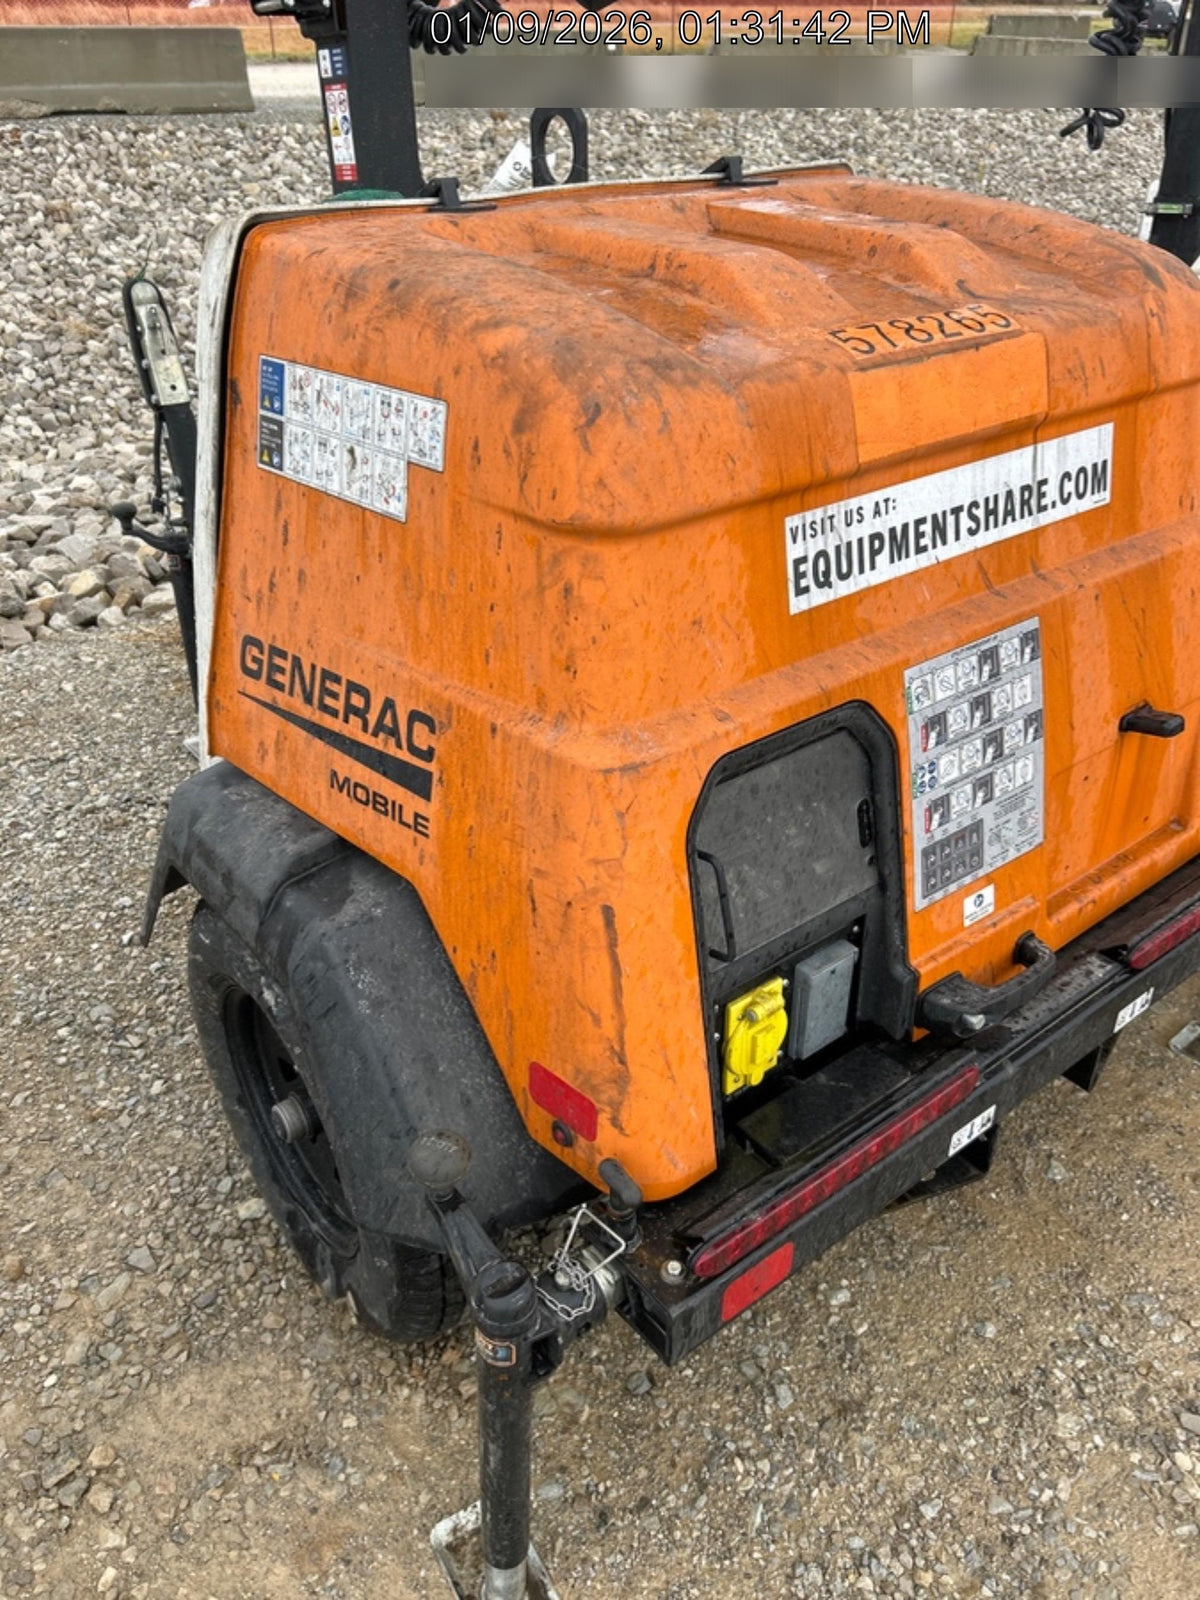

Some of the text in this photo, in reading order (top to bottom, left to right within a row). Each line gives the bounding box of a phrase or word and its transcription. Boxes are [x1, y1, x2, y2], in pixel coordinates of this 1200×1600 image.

[829, 304, 1011, 354] 578265
[790, 497, 896, 544] VISIT US AT:
[792, 459, 1108, 597] EQUIPMENTSHARE.COM
[240, 634, 436, 763] GENERAC
[330, 769, 430, 839] MOBILE
